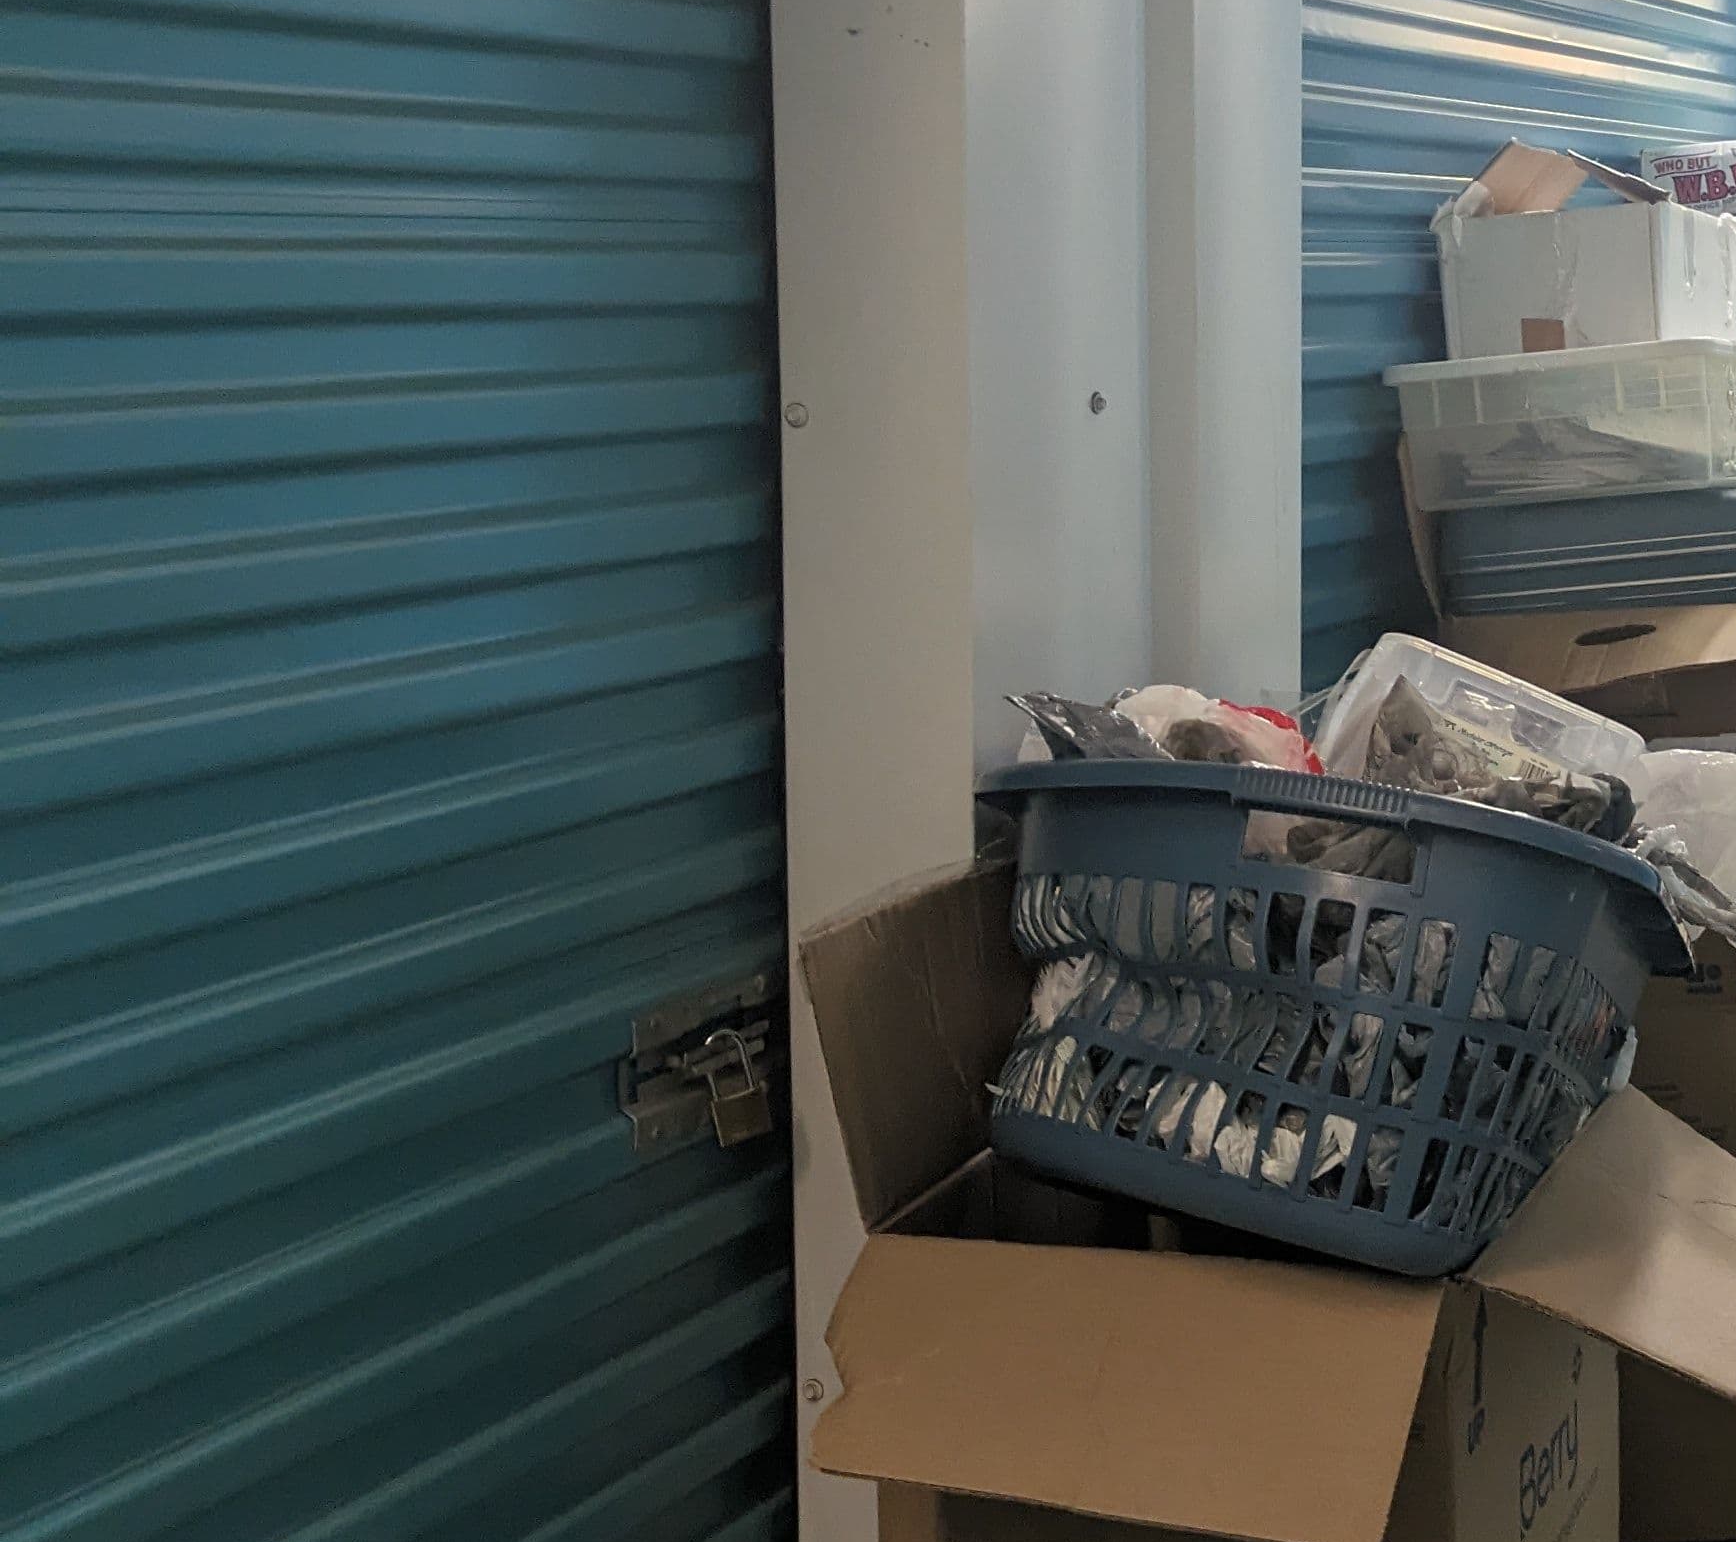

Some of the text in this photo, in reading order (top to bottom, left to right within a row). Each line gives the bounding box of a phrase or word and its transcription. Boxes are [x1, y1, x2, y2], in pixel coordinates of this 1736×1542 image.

[1654, 156, 1712, 174] WHO BUT
[1518, 1398, 1579, 1535] Berry
